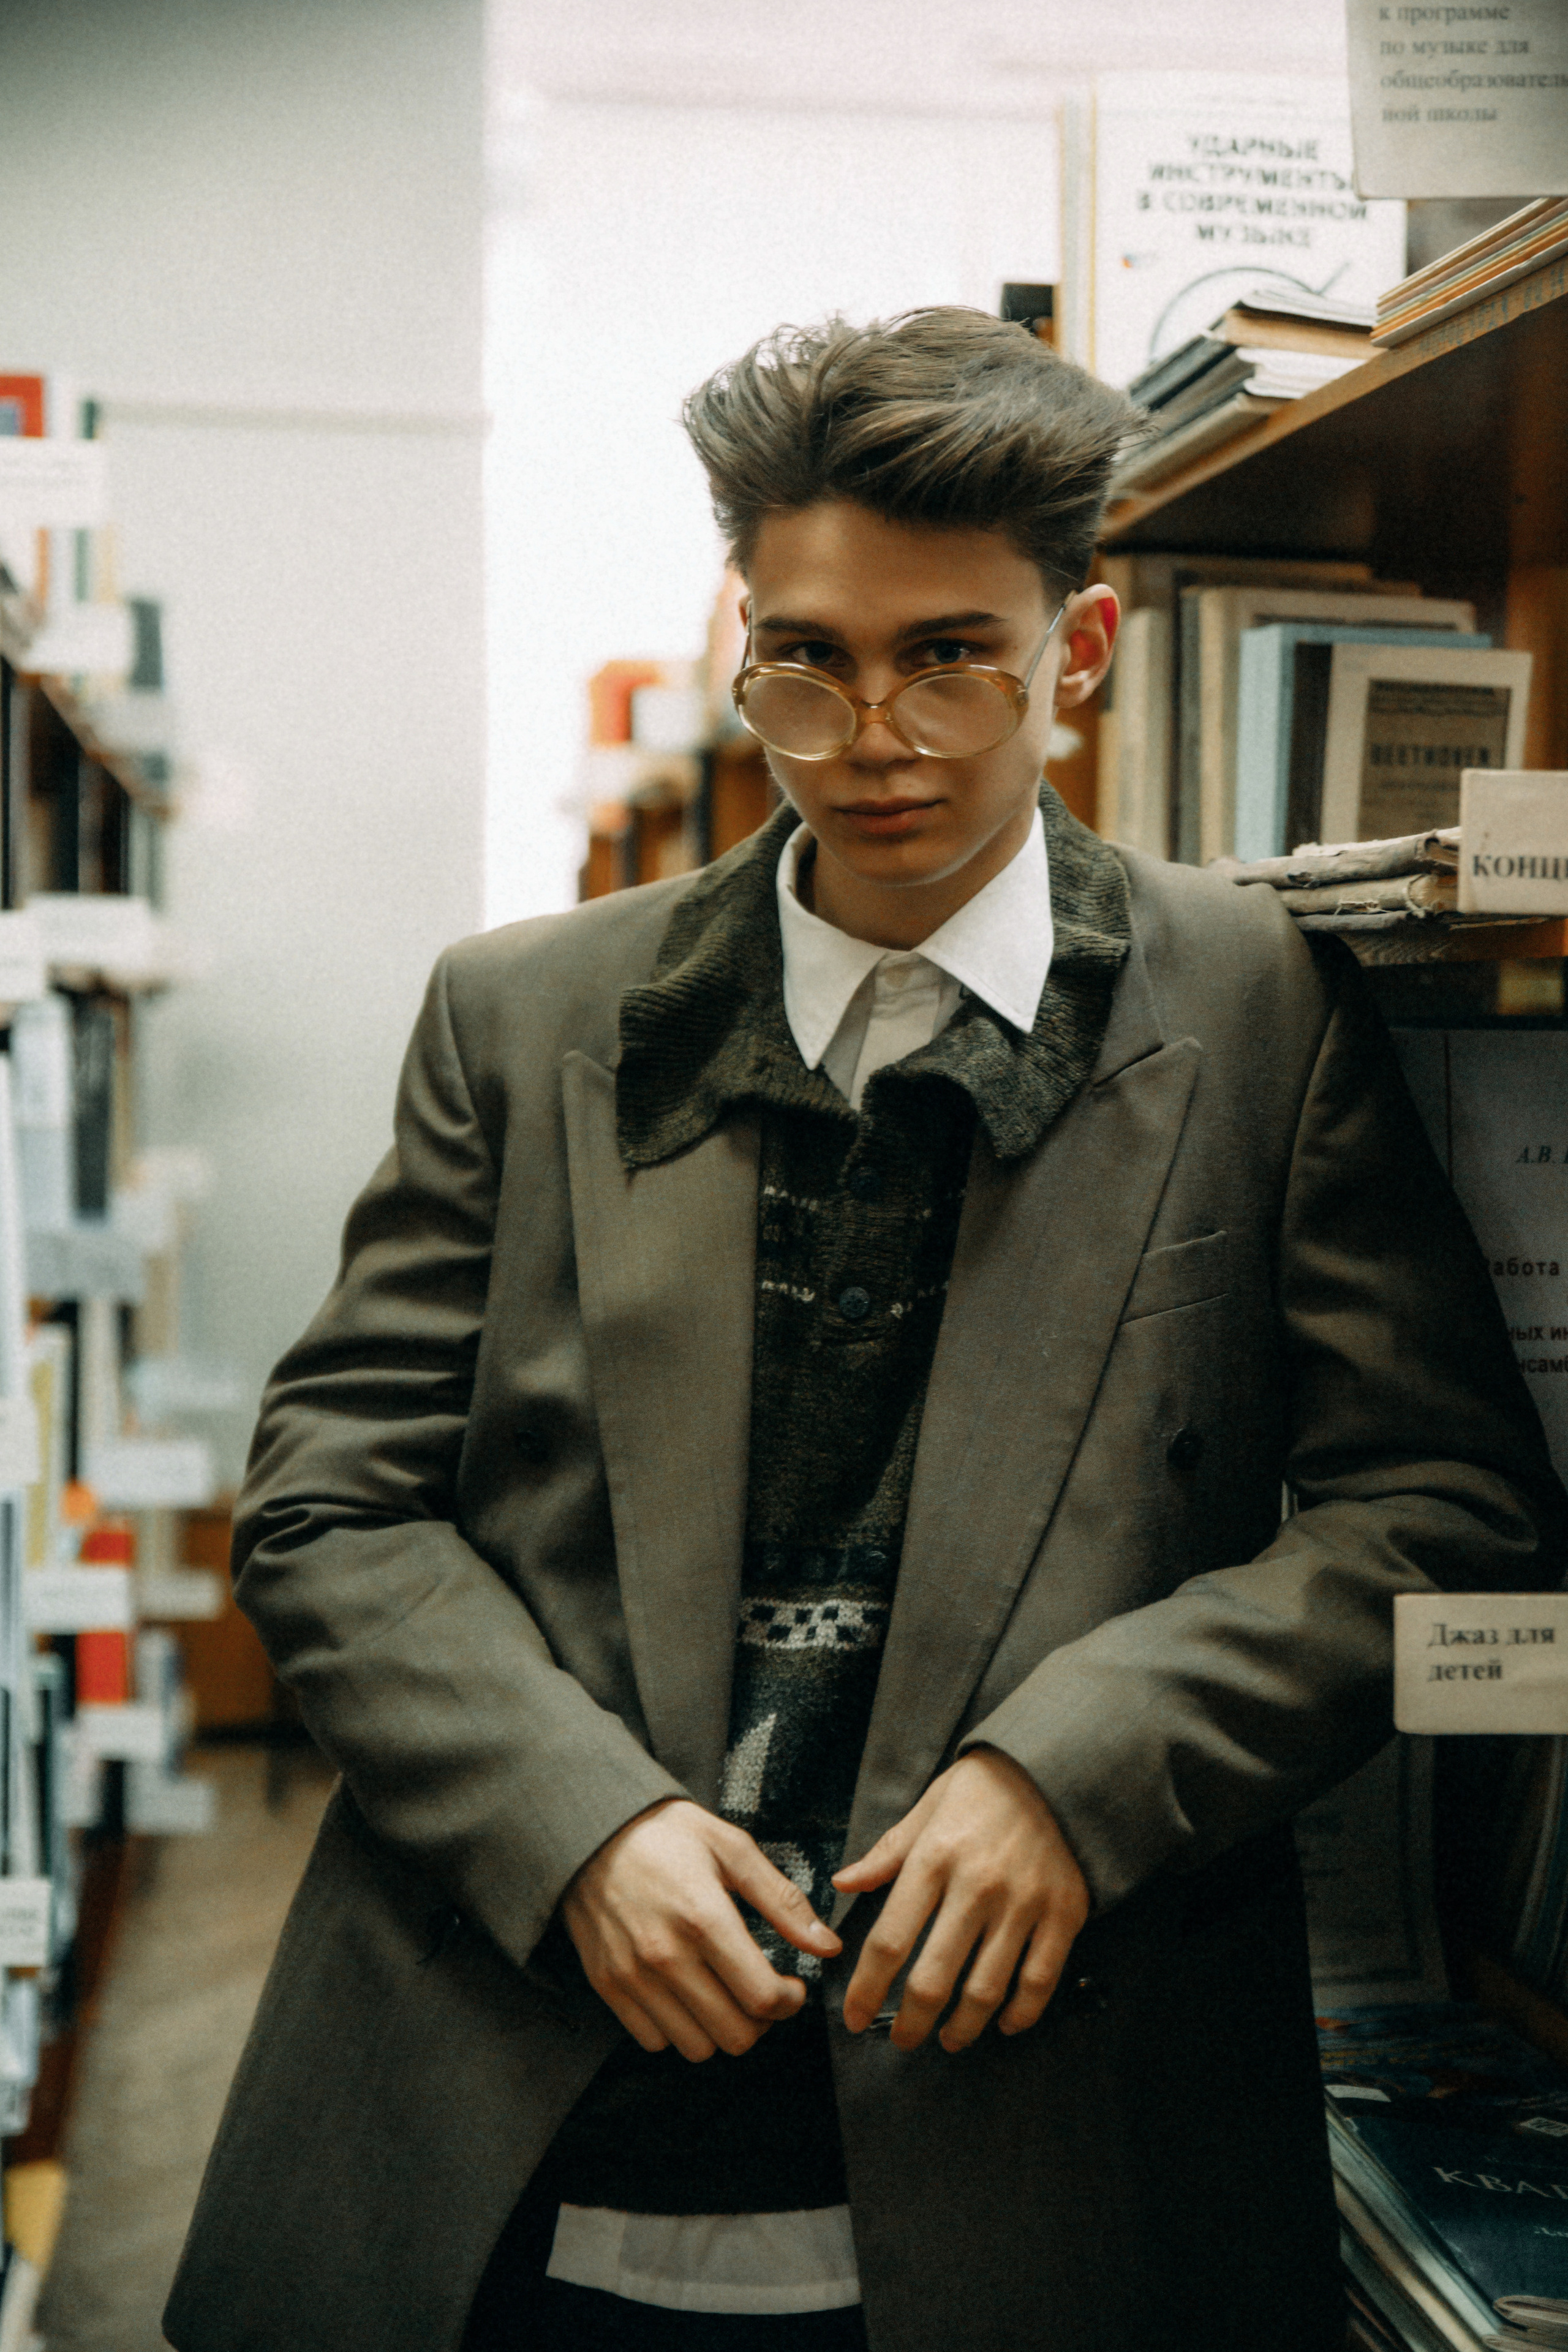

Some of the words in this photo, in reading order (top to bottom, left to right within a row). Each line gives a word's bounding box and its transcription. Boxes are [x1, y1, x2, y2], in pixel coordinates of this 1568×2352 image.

[1379, 6, 1390, 21] к
[1397, 6, 1510, 26] программе
[1379, 40, 1405, 55] по
[1412, 40, 1488, 59] музыке
[1495, 40, 1529, 55] для
[1382, 102, 1420, 121] ной
[1427, 107, 1497, 122] школы
[1188, 135, 1319, 160] УДАРНЫЕ
[1137, 192, 1152, 212] В
[1196, 224, 1311, 248] МУЗЫКЕ
[1472, 854, 1568, 883] КОНЦ
[1485, 1257, 1559, 1276] абота
[1427, 1623, 1498, 1648] Джаз
[1505, 1626, 1555, 1646] для
[1427, 1659, 1503, 1683] детей
